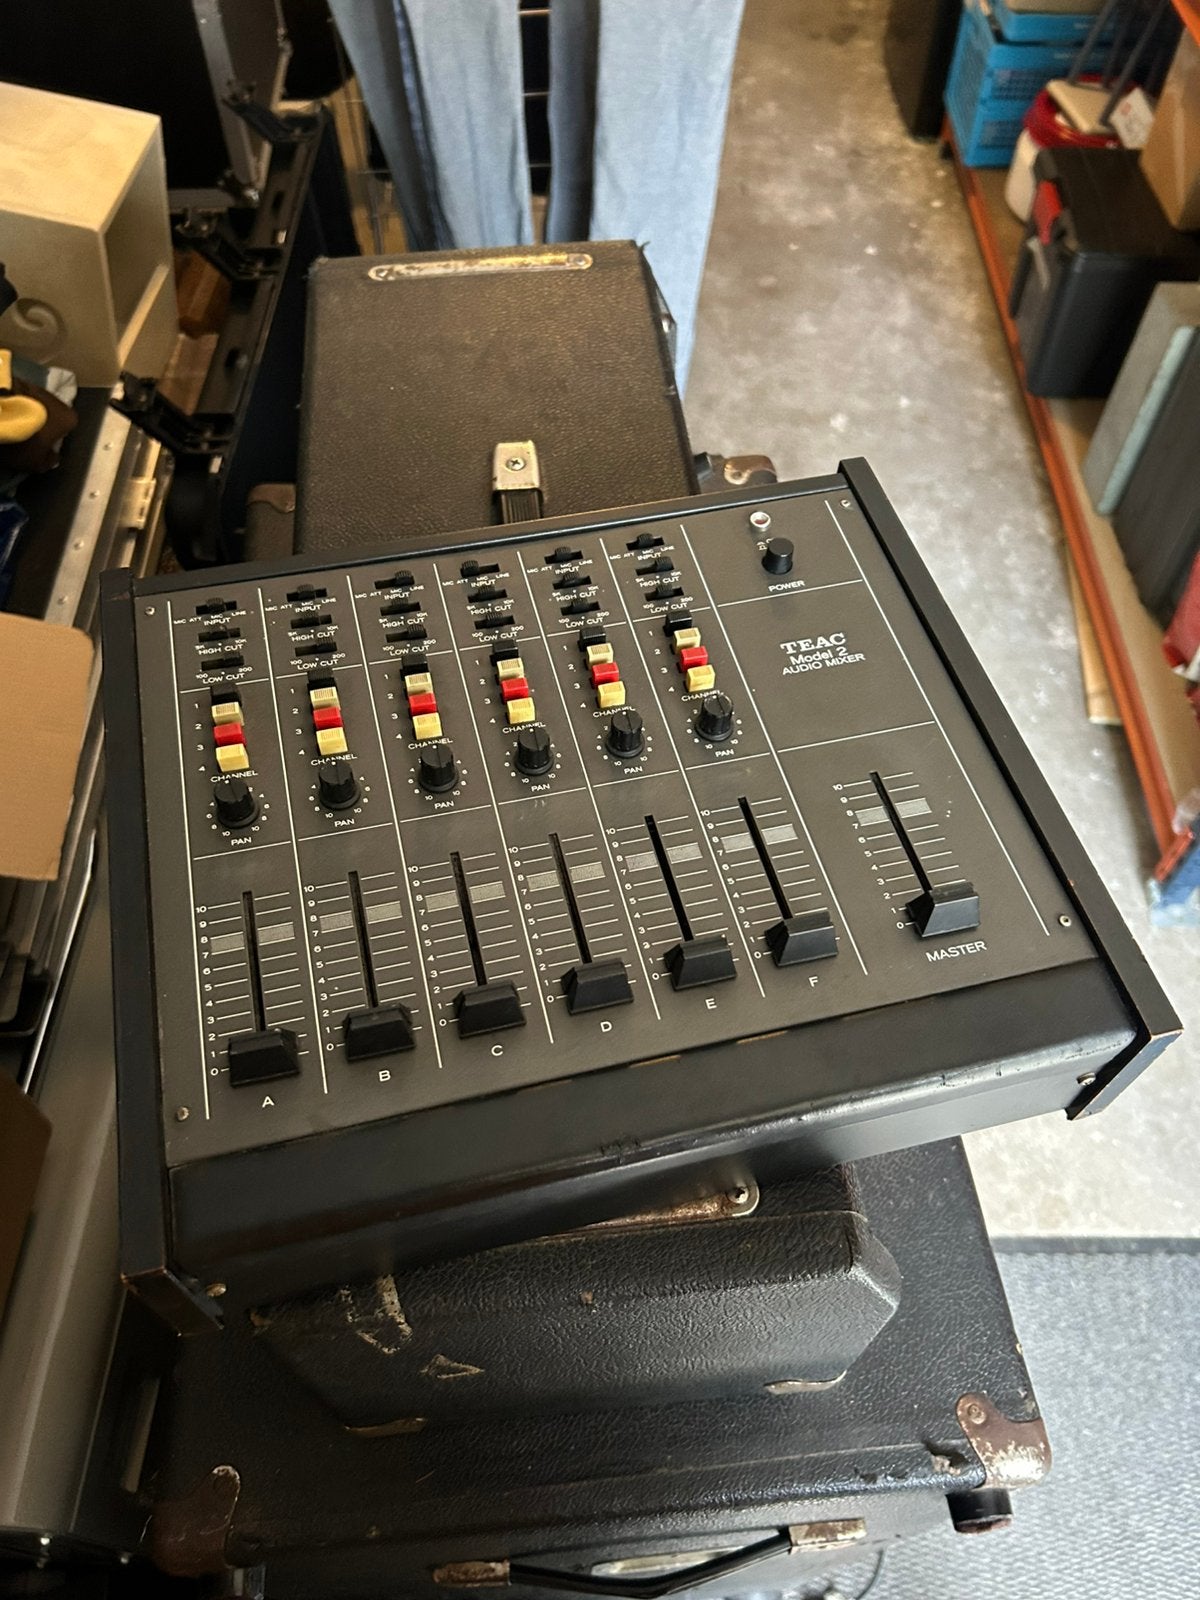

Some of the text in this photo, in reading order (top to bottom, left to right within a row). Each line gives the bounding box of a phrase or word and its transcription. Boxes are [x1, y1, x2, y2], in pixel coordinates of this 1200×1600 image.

[637, 552, 662, 560] INPUT
[555, 566, 580, 574] INPUT
[471, 579, 496, 587] INPUT
[663, 577, 680, 585] CUT
[768, 580, 806, 592] POWER
[384, 592, 410, 600] INPUT
[556, 593, 577, 601] HIGH
[295, 604, 321, 613] INPUT
[470, 604, 512, 615] HIGH CUT
[650, 602, 688, 613] LOW CUT
[204, 617, 231, 626] INPUT
[382, 617, 426, 628] HIGH CUT
[566, 617, 604, 628] LOW CUT
[291, 630, 335, 641] HIGH CUT
[479, 631, 518, 642] LOW CUT
[199, 644, 243, 655] HIGH CUT
[781, 633, 846, 655] TEAC
[390, 645, 430, 656] LOW CUT
[790, 646, 849, 666] Model 2
[297, 658, 339, 670] LOW CUT
[782, 653, 866, 676] AUDIO MIXER
[203, 672, 245, 684] LOW CUT
[715, 749, 734, 757] PAN
[531, 784, 551, 792] PAN
[833, 783, 843, 791] 10
[434, 801, 454, 809] PAN
[334, 818, 355, 827] PAN
[231, 837, 252, 845] PAN
[754, 951, 762, 959] 0
[926, 940, 987, 962] MASTER
[809, 976, 819, 987] F
[706, 998, 717, 1010] E
[600, 1021, 613, 1032] D
[208, 1033, 215, 1041] 2
[491, 1044, 504, 1056] C
[211, 1068, 218, 1076] 0
[379, 1070, 391, 1082] B
[262, 1096, 274, 1107] A
